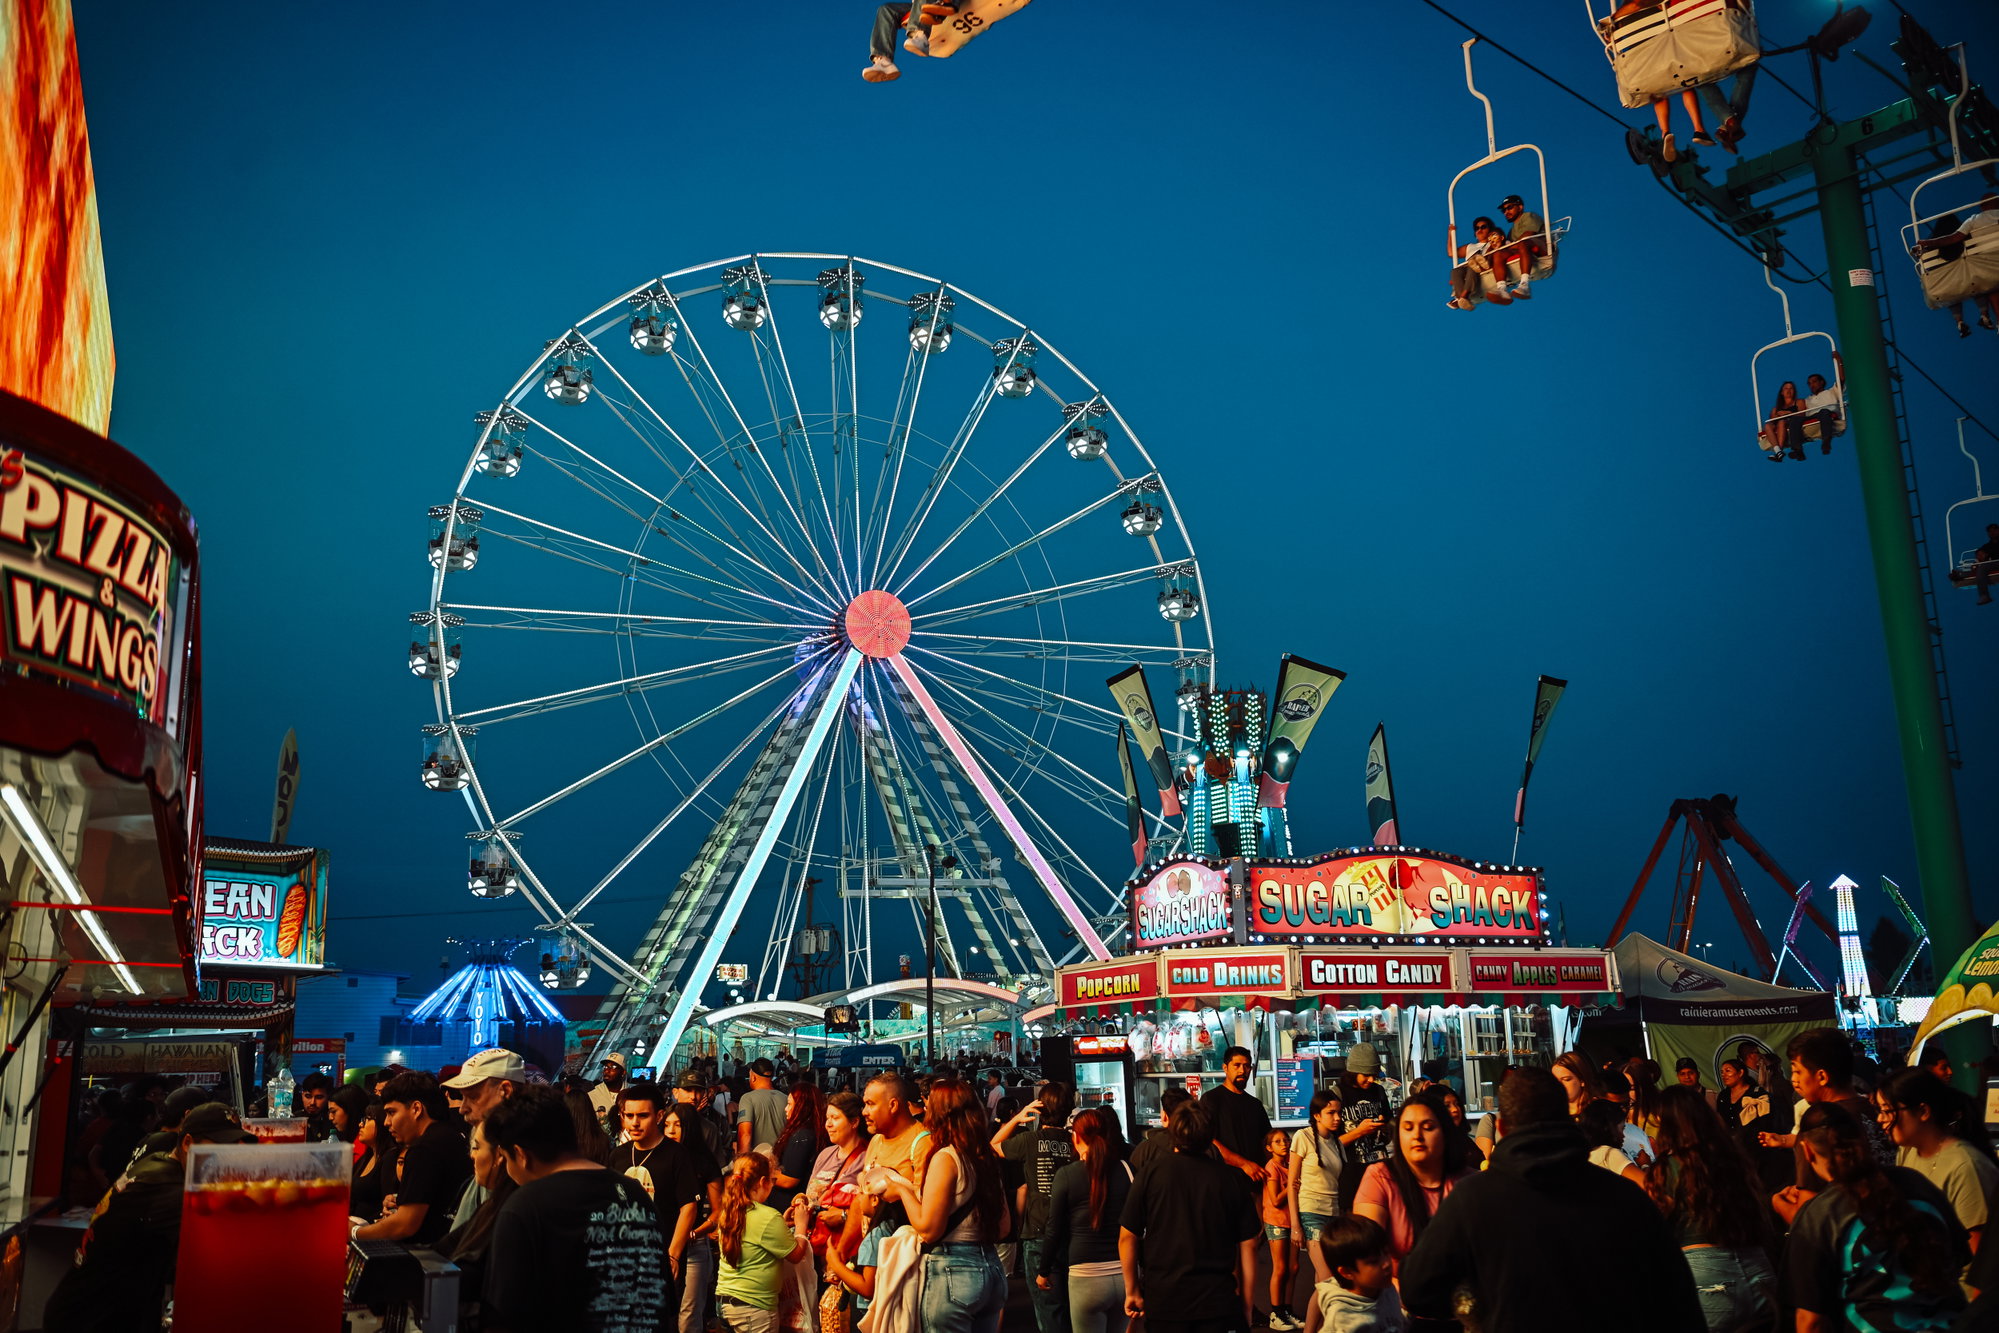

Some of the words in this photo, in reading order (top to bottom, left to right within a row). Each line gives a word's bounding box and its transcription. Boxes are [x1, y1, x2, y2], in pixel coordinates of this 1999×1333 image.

[952, 12, 984, 34] 96
[0, 470, 168, 612] PIZZA
[100, 577, 115, 607] &
[12, 576, 158, 700] WINGS
[1259, 880, 1372, 927] SUGAR
[1429, 882, 1536, 930] SHACK
[1172, 967, 1209, 984] COLD
[1213, 962, 1283, 987] DRINKS
[1310, 959, 1378, 985] COTTON
[1386, 959, 1443, 985] CANDY
[1475, 964, 1507, 981] CANDY
[1512, 961, 1557, 985] APPLES
[1561, 965, 1604, 981] CARAMEL
[226, 981, 275, 1003] DOGS
[1076, 973, 1140, 999] POPCORN
[1680, 1006, 1799, 1018] rainieramusements.com
[84, 1045, 125, 1058] OLD
[151, 1044, 227, 1057] HAWAIIAN
[862, 1056, 896, 1065] ENTER
[1038, 1140, 1071, 1154] MOD
